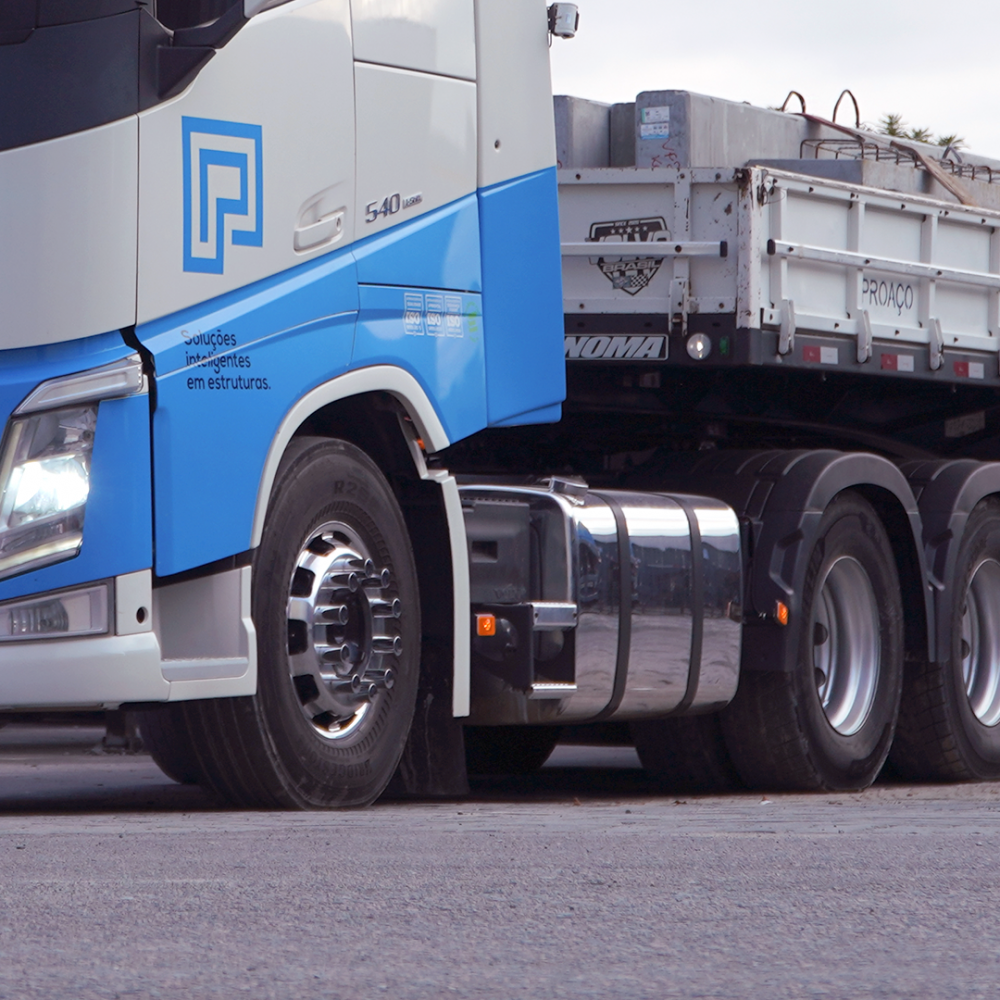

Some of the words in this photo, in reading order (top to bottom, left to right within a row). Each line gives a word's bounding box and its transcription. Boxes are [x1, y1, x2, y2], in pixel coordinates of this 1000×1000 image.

[365, 192, 400, 224] 540
[602, 260, 661, 273] BRASIL
[862, 278, 914, 316] PROAÇO
[180, 329, 237, 352] Soluções
[564, 336, 664, 358] NOMA
[185, 351, 251, 374] inteligentes
[187, 377, 205, 390] em
[207, 375, 271, 390] estruturas.
